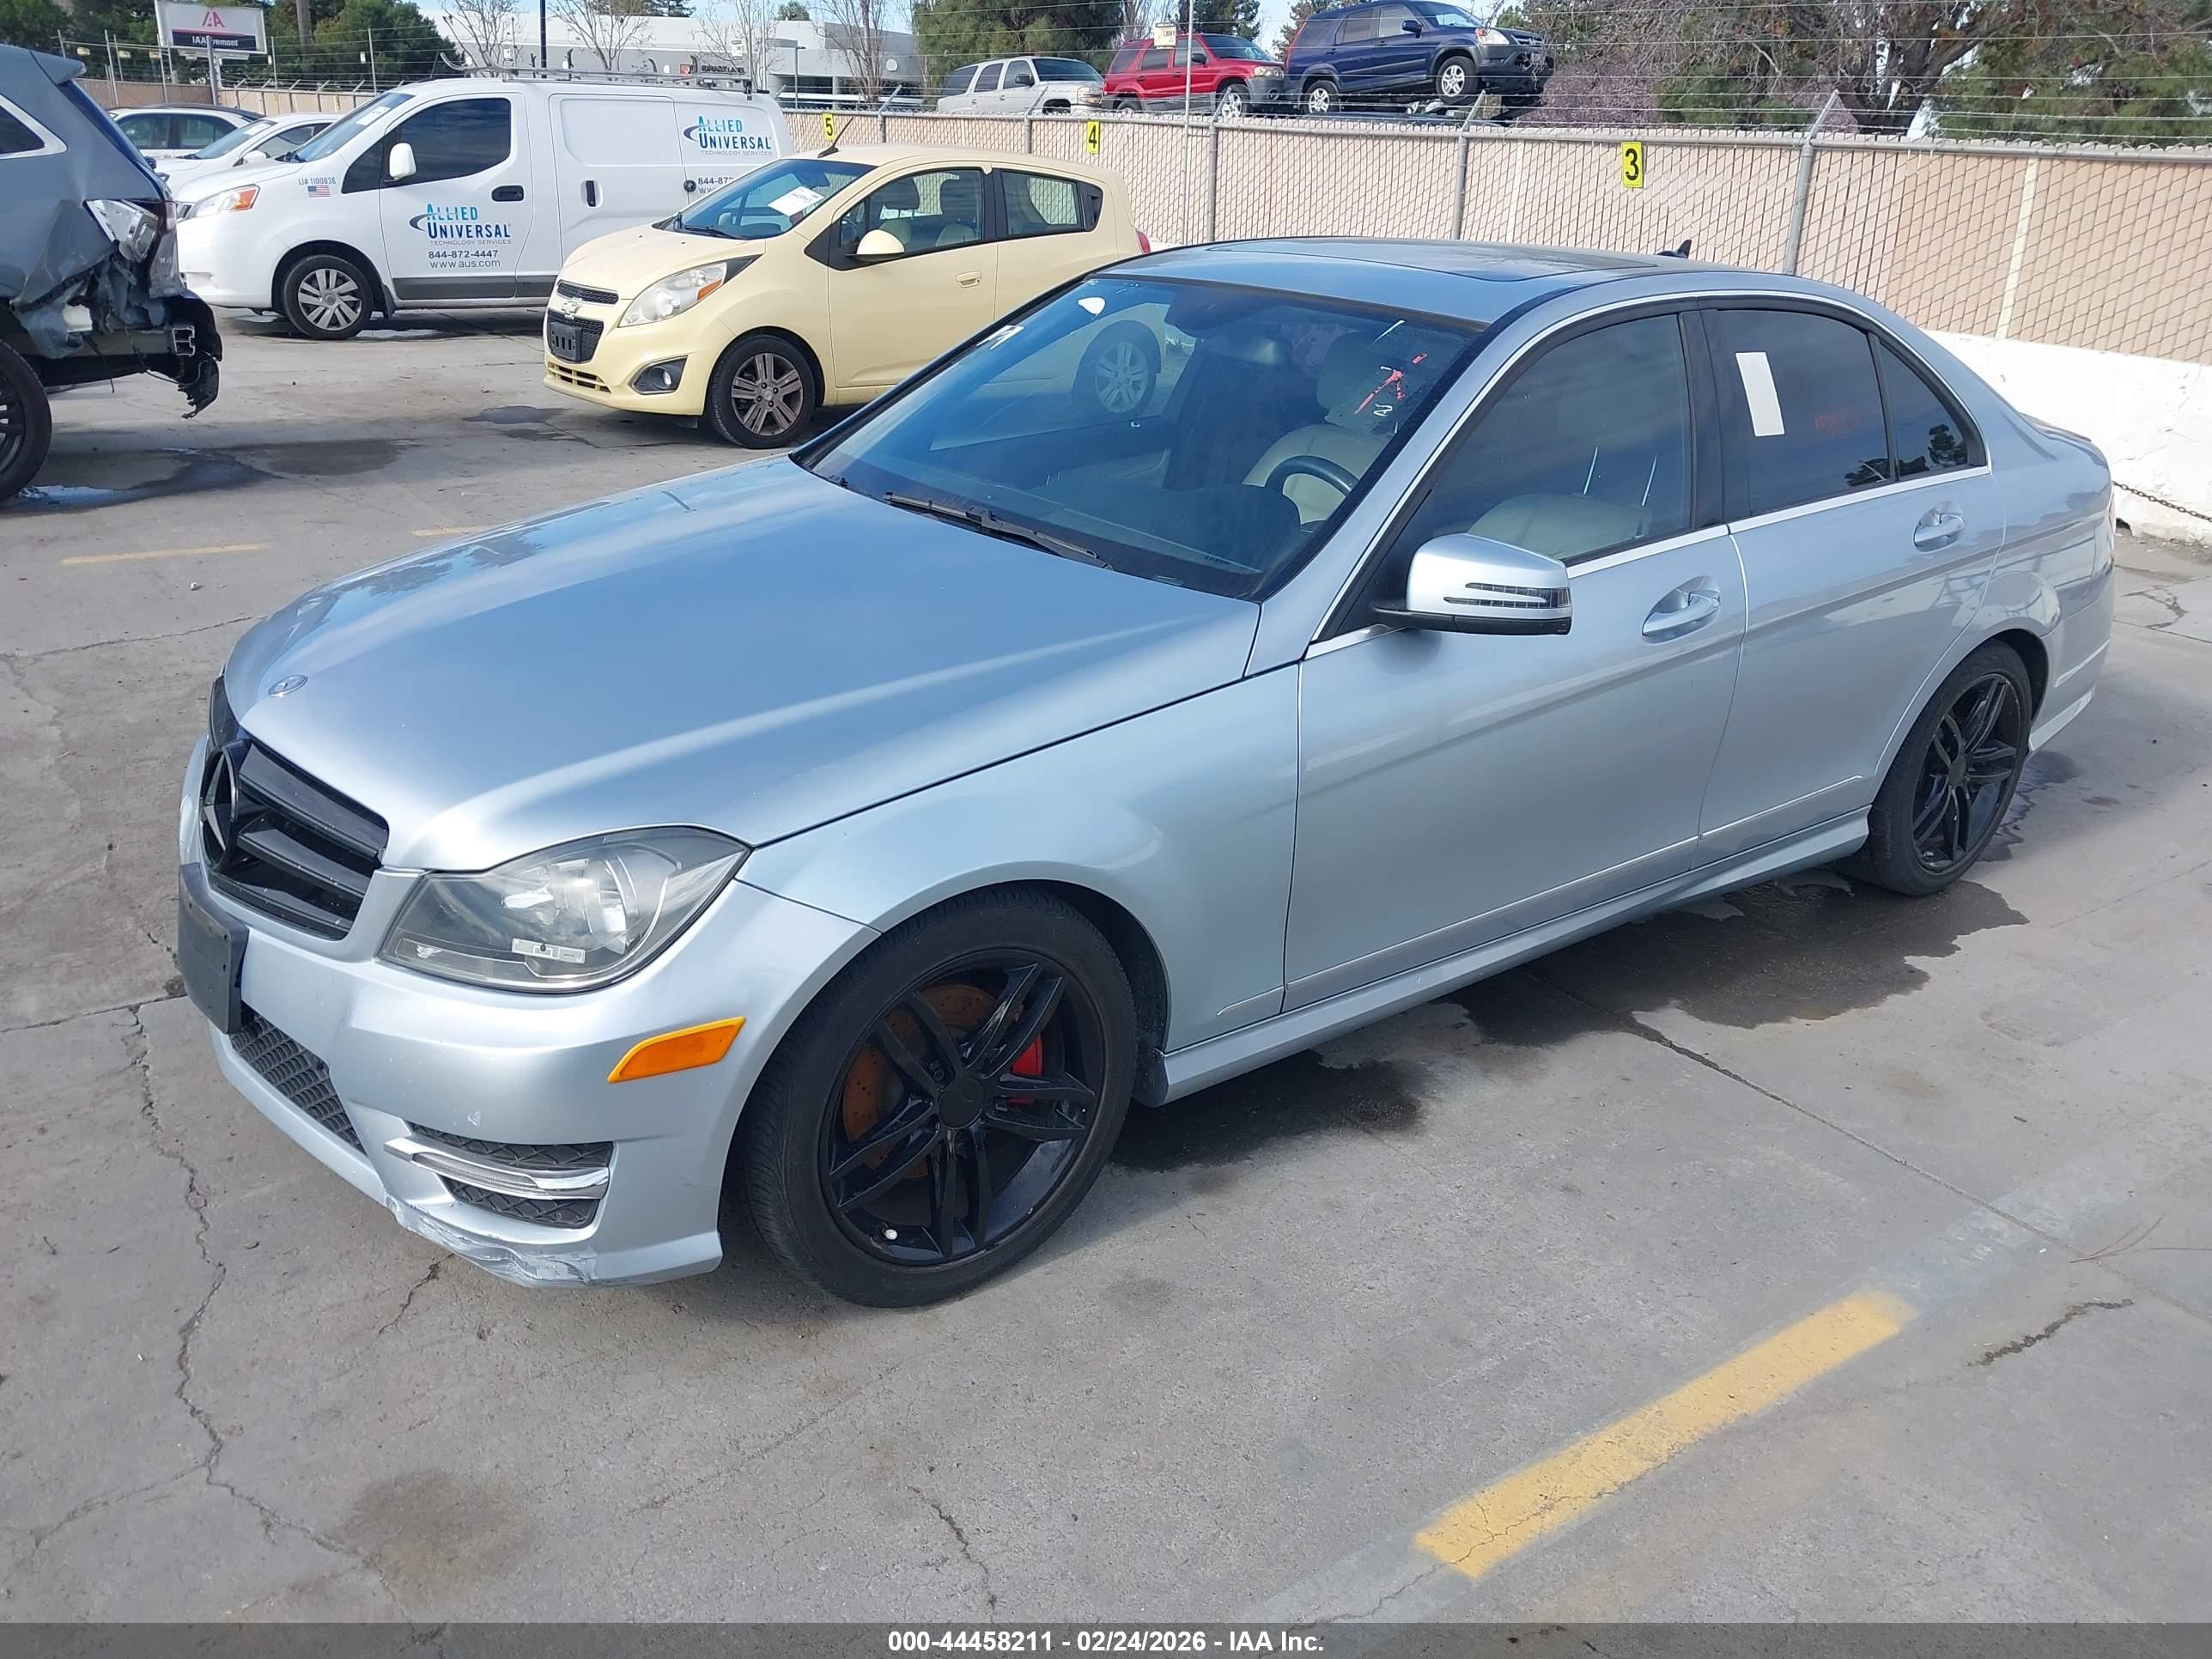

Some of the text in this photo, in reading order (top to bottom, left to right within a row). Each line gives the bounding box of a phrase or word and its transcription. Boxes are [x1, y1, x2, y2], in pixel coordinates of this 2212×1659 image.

[191, 35, 239, 46] IAA remont
[698, 115, 743, 132] ALLIED
[825, 117, 833, 137] 5
[699, 132, 771, 149] UNIVERSAL
[1088, 125, 1097, 149] 4
[1625, 148, 1639, 181] 3
[427, 204, 478, 221] ALLIED
[428, 222, 511, 239] UNIVERSAL
[428, 250, 498, 259] 844-872-4447
[429, 259, 501, 269] www.aus.com
